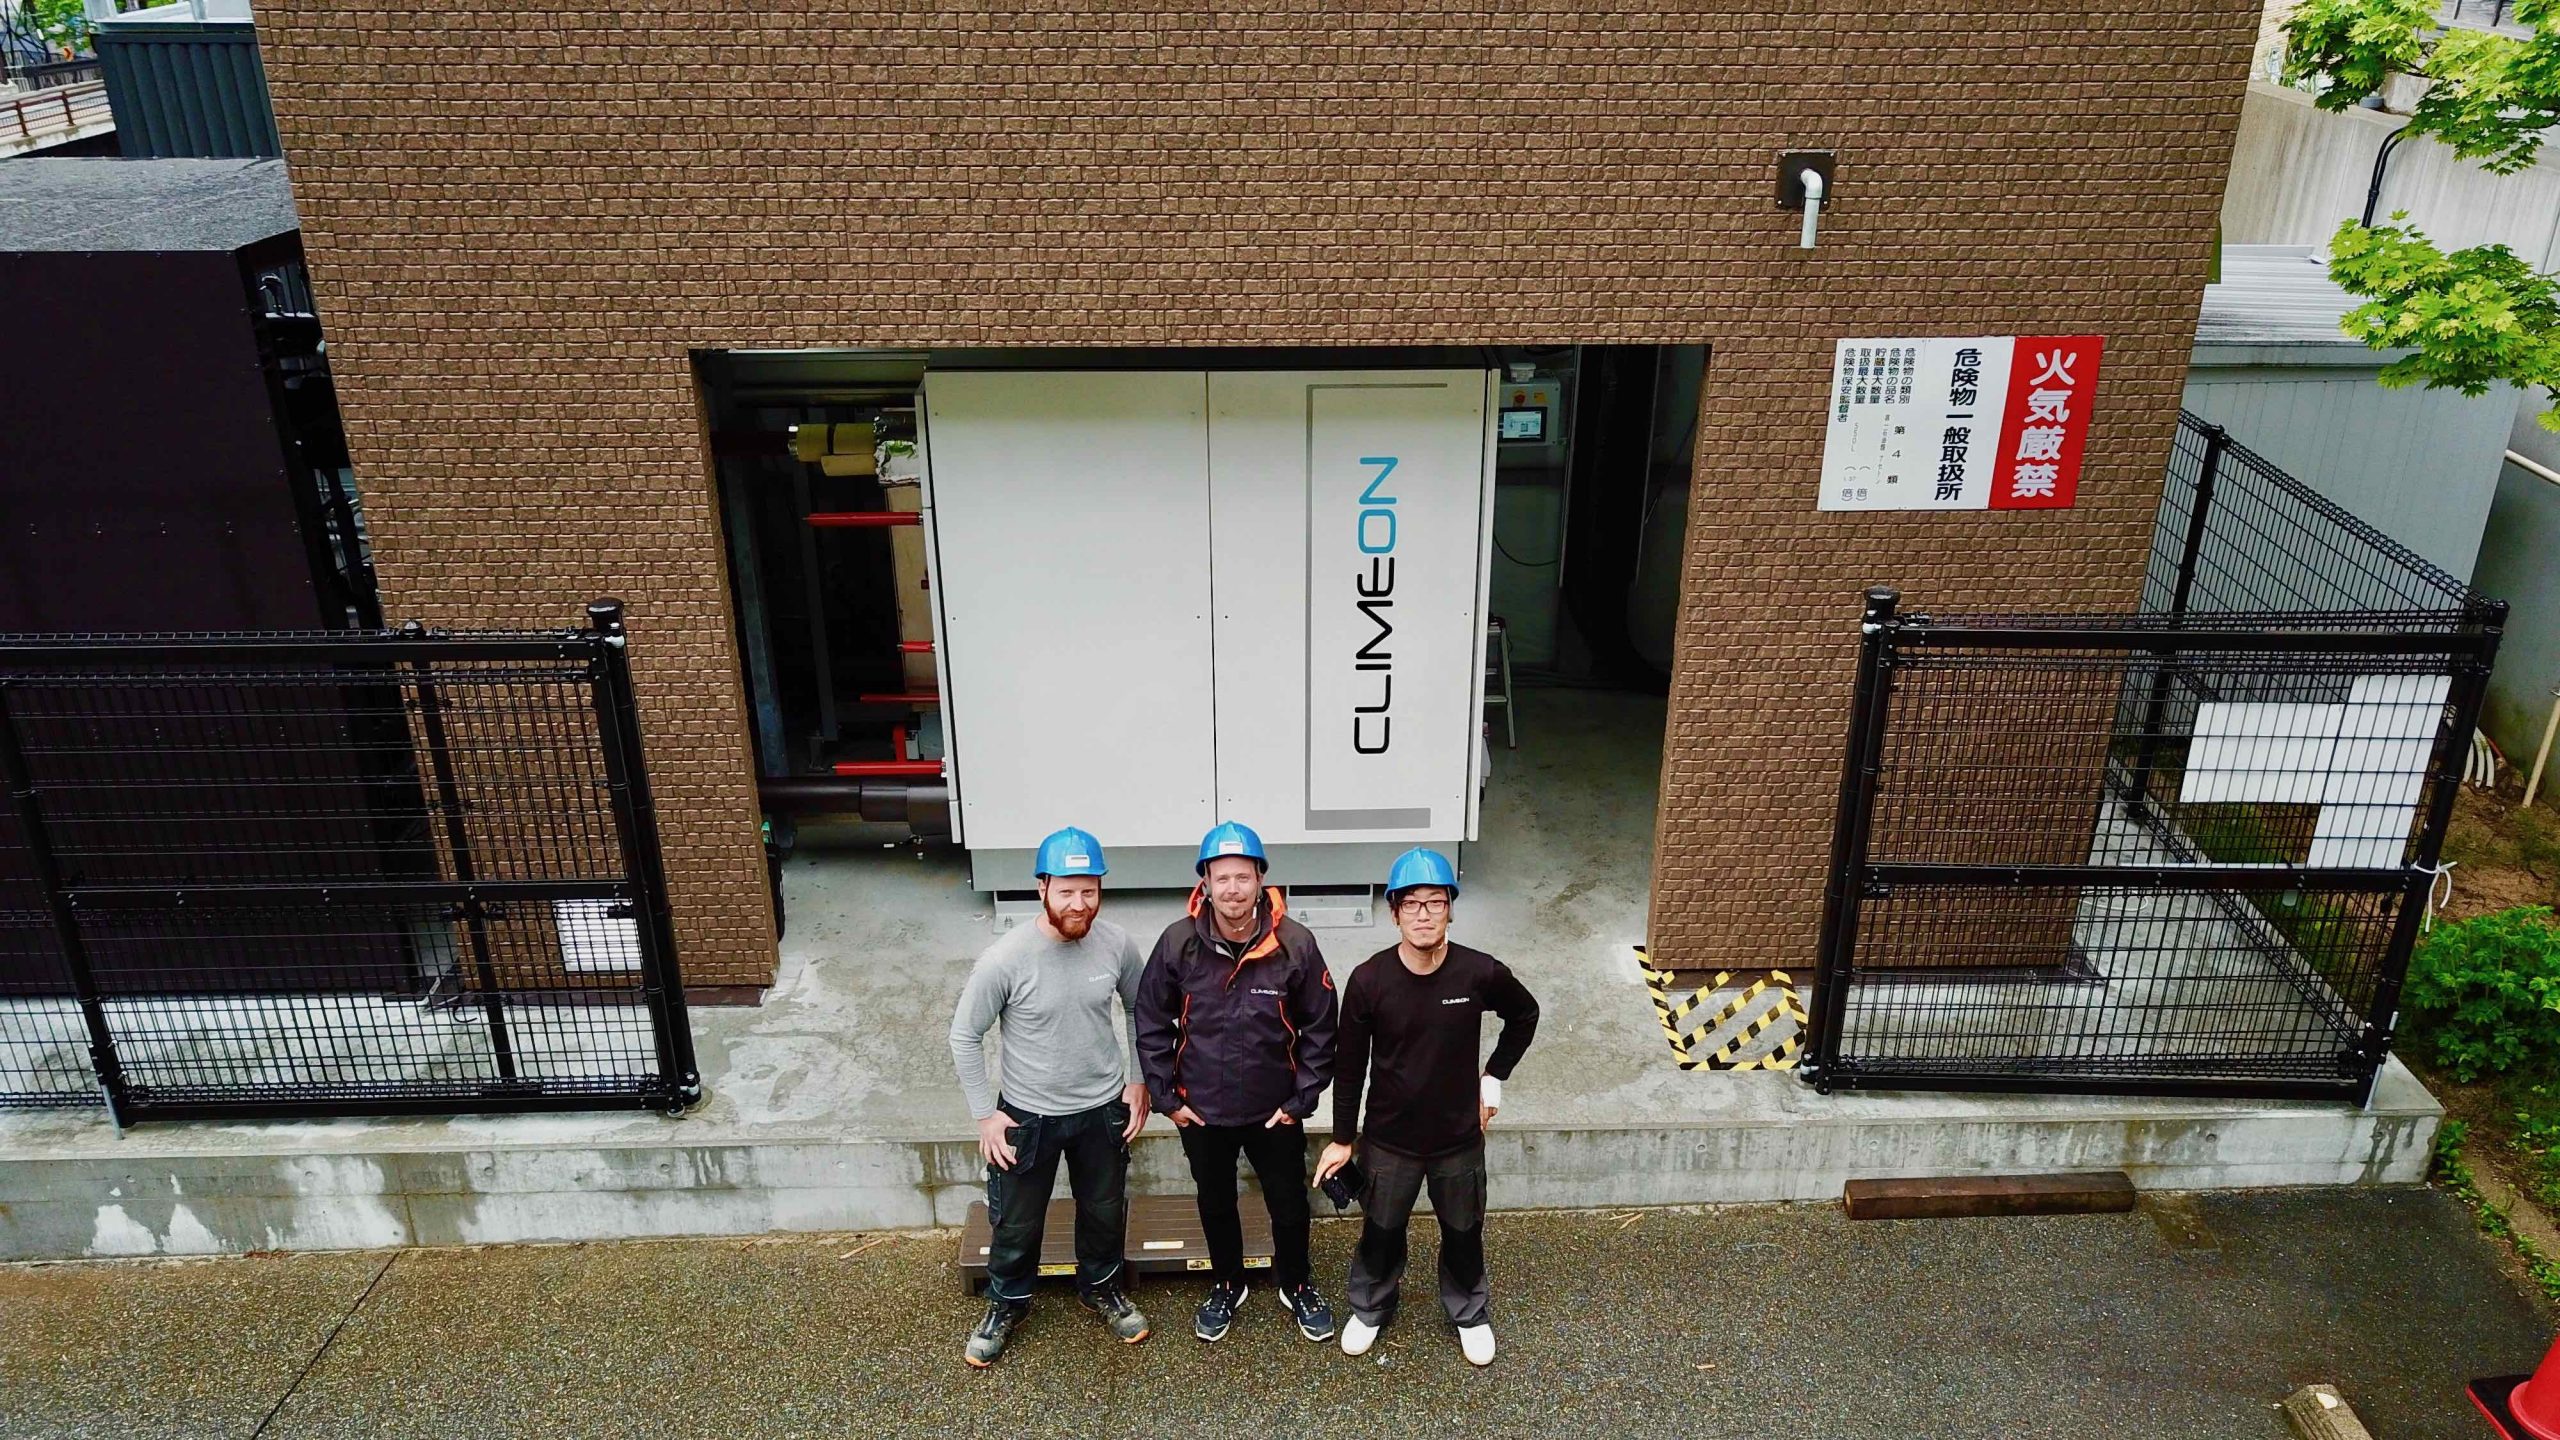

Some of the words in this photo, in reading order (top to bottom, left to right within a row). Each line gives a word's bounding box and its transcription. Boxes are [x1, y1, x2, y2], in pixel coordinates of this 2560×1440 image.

[1837, 348, 1856, 422] 危険物保安監督者
[1854, 348, 1872, 405] 取扱最大数量
[1869, 348, 1887, 405] 貯蔵最大数量
[1884, 348, 1901, 405] 危険物の品名
[1898, 348, 1916, 405] 危険物の類別
[1934, 348, 1982, 501] 危険物一般取扱所
[2011, 348, 2078, 498] 火気厳禁
[1354, 456, 1399, 755] CLIMEON
